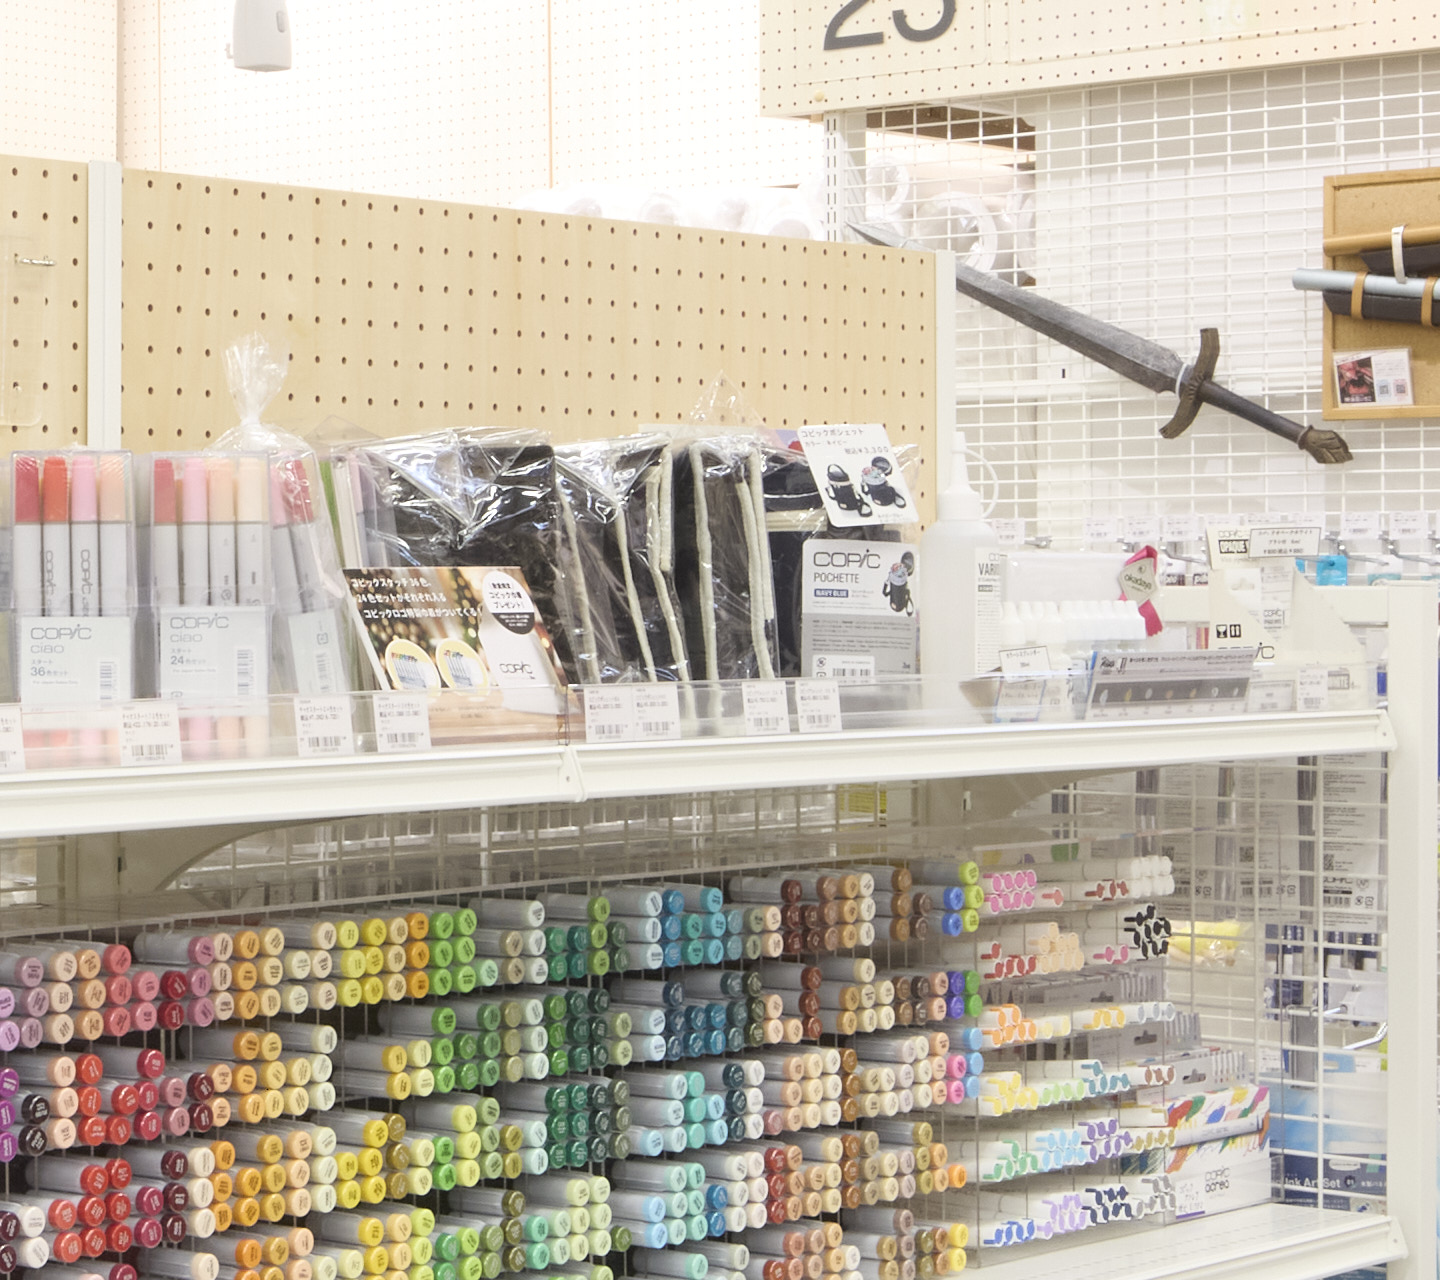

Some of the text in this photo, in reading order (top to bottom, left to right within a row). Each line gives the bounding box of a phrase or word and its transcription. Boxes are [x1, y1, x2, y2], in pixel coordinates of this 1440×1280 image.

[812, 548, 881, 569] COPIC
[813, 572, 860, 584] POCHETTE
[169, 612, 230, 630] COPIC
[30, 624, 93, 641] COPIC
[169, 631, 204, 643] ciao
[30, 642, 65, 654] ciao
[499, 660, 533, 676] COPIC
